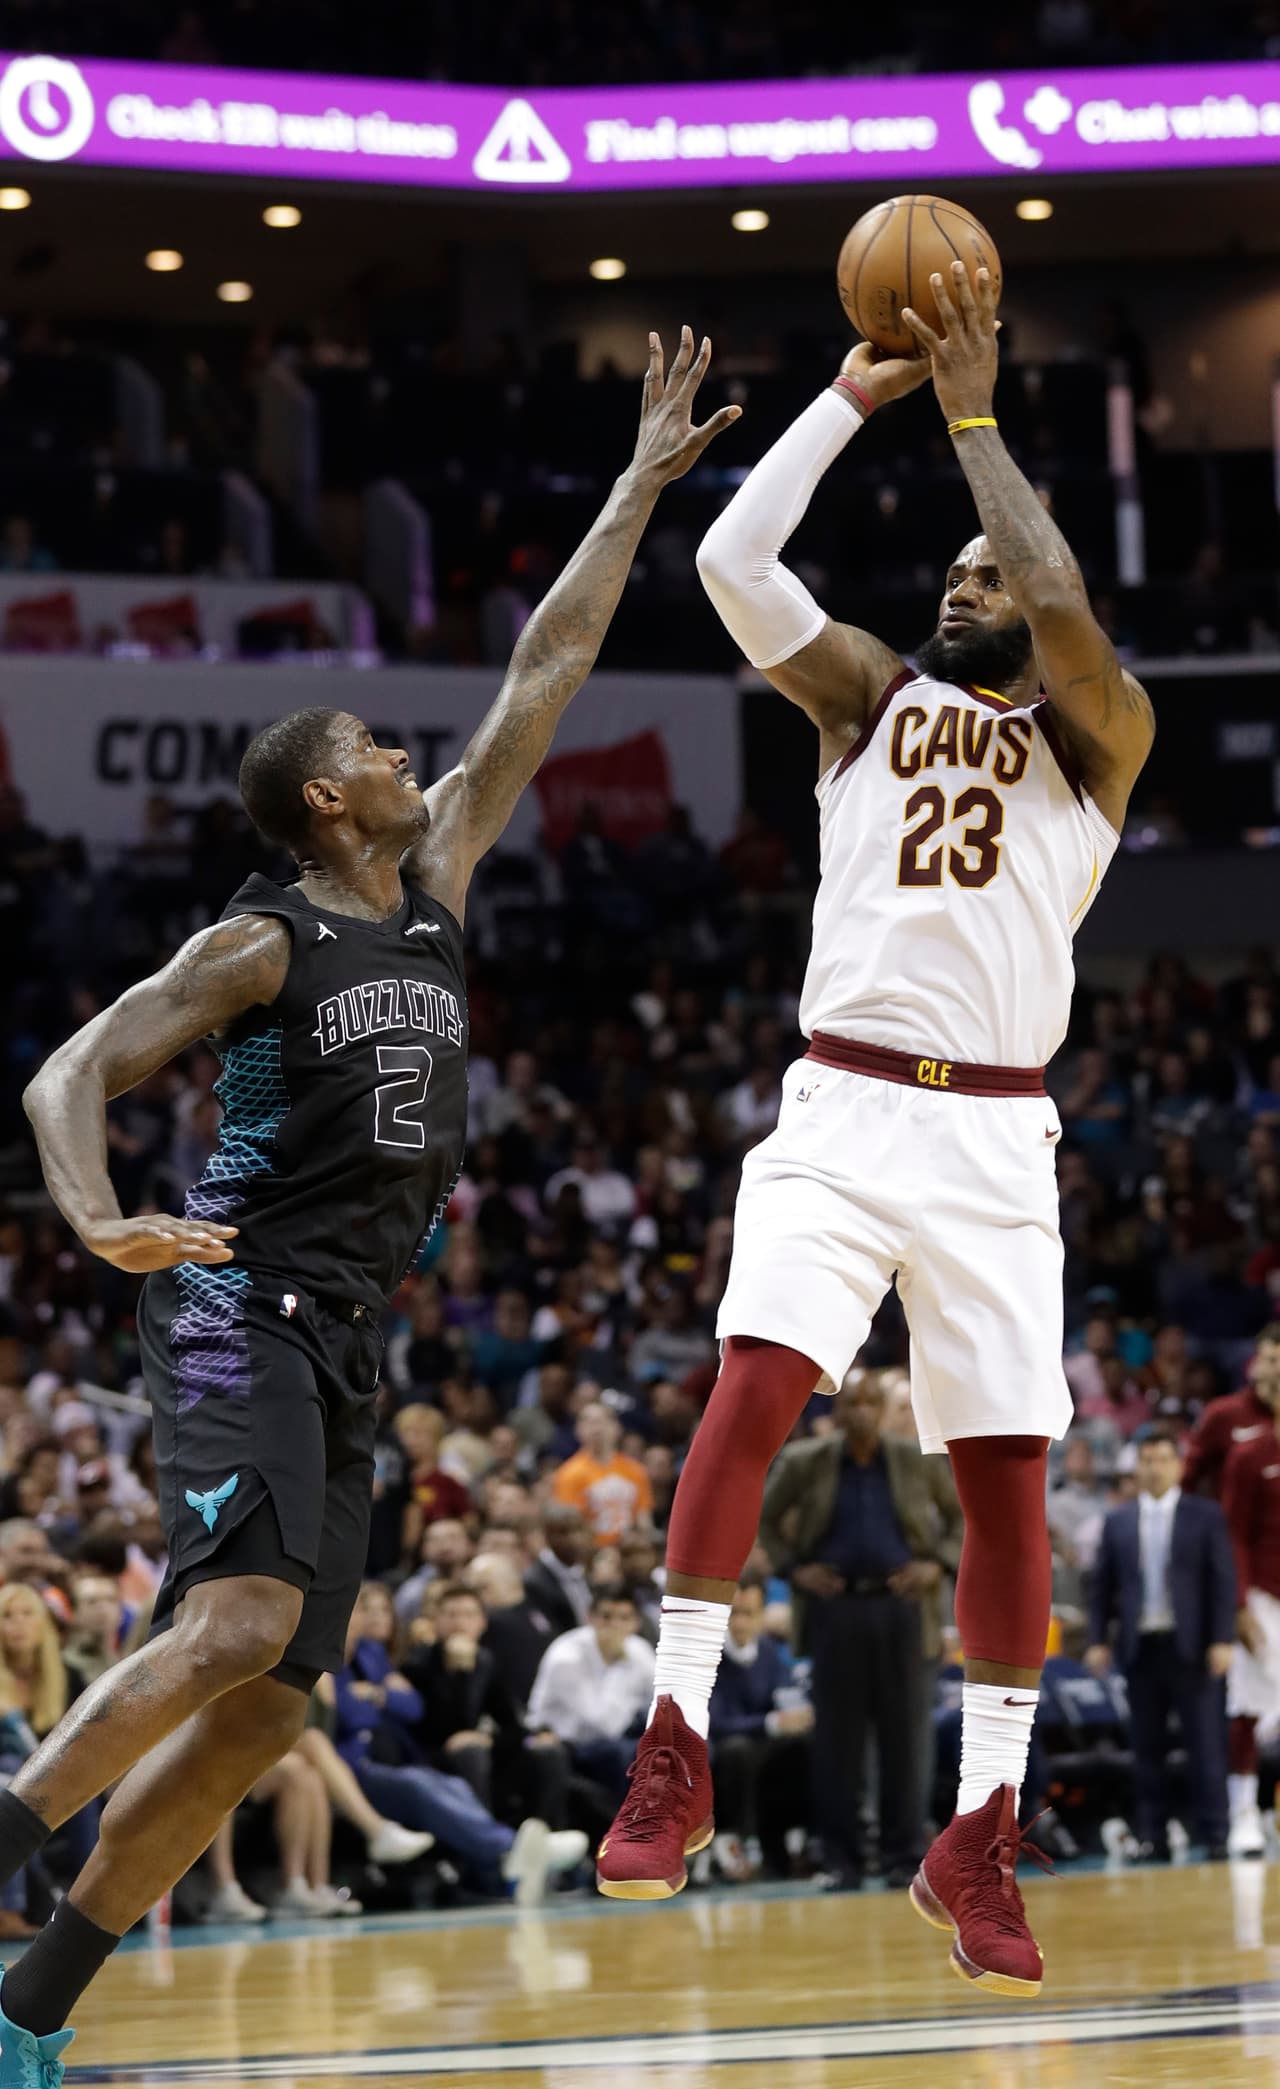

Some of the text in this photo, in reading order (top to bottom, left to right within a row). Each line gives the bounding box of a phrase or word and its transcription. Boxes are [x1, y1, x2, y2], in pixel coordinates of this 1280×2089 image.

[107, 93, 220, 143] Check
[279, 107, 356, 153] wait
[356, 110, 458, 159] times
[584, 115, 938, 163] Find an urgent care
[1076, 98, 1170, 144] Chat
[1168, 94, 1259, 140] with
[889, 705, 1033, 787] CAVS
[896, 784, 1005, 890] 23
[312, 979, 464, 1056] BUZZ CITY
[374, 1045, 433, 1149] 2
[916, 1058, 953, 1088] CLE
